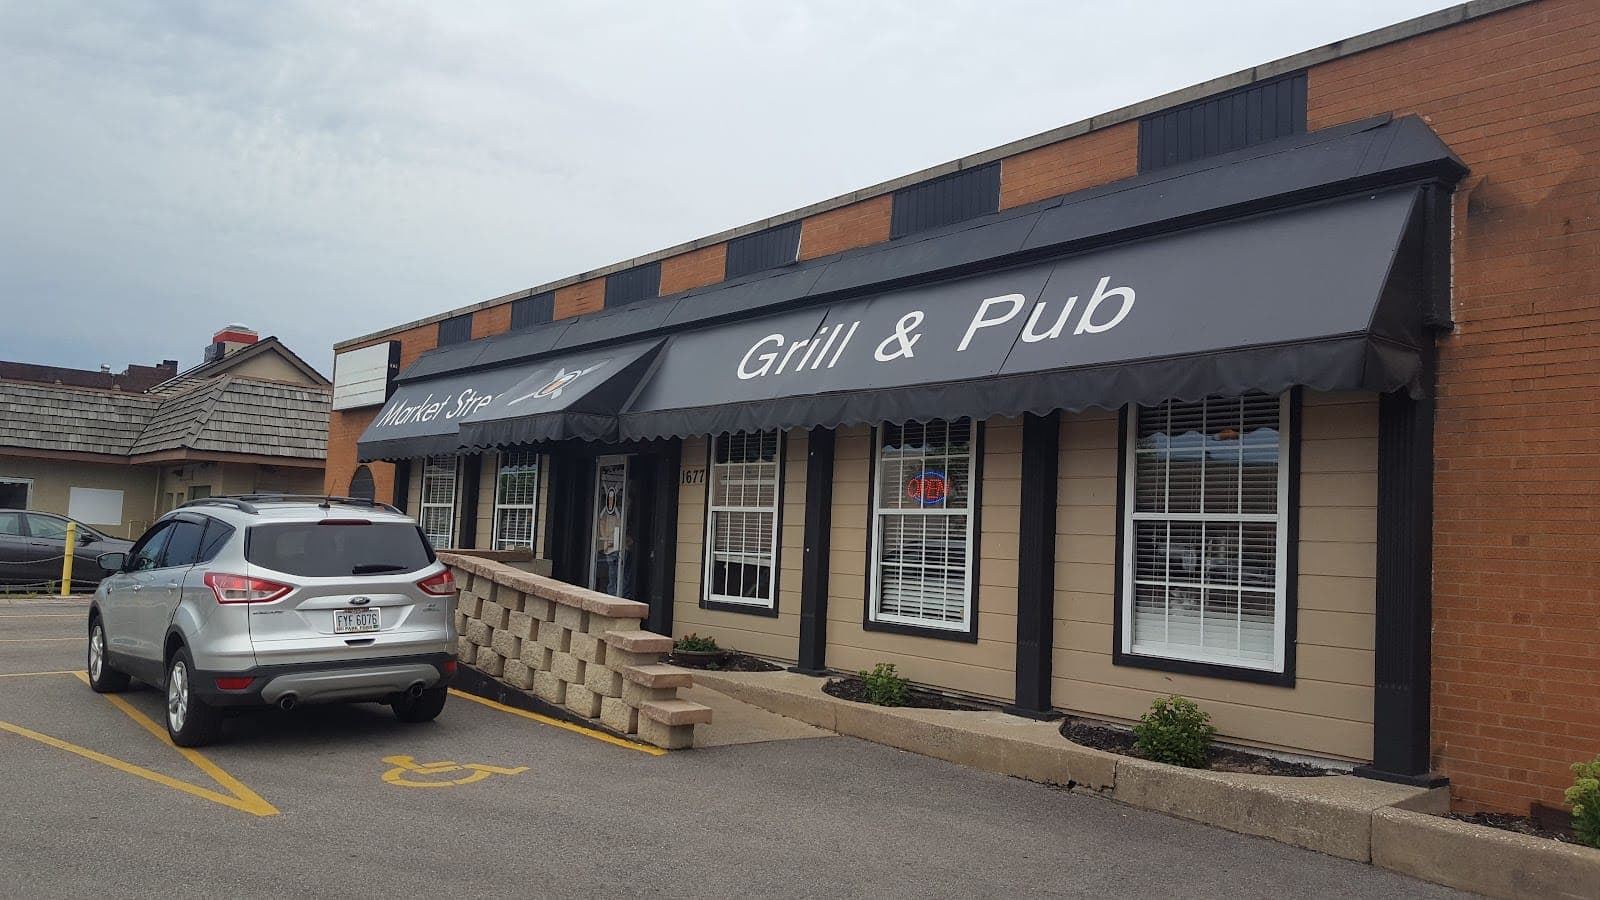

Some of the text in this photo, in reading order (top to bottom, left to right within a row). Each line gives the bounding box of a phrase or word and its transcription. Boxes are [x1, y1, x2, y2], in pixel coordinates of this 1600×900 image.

[736, 275, 1137, 380] Grill & Pub
[376, 388, 504, 428] Market Stre
[681, 469, 705, 484] 1677
